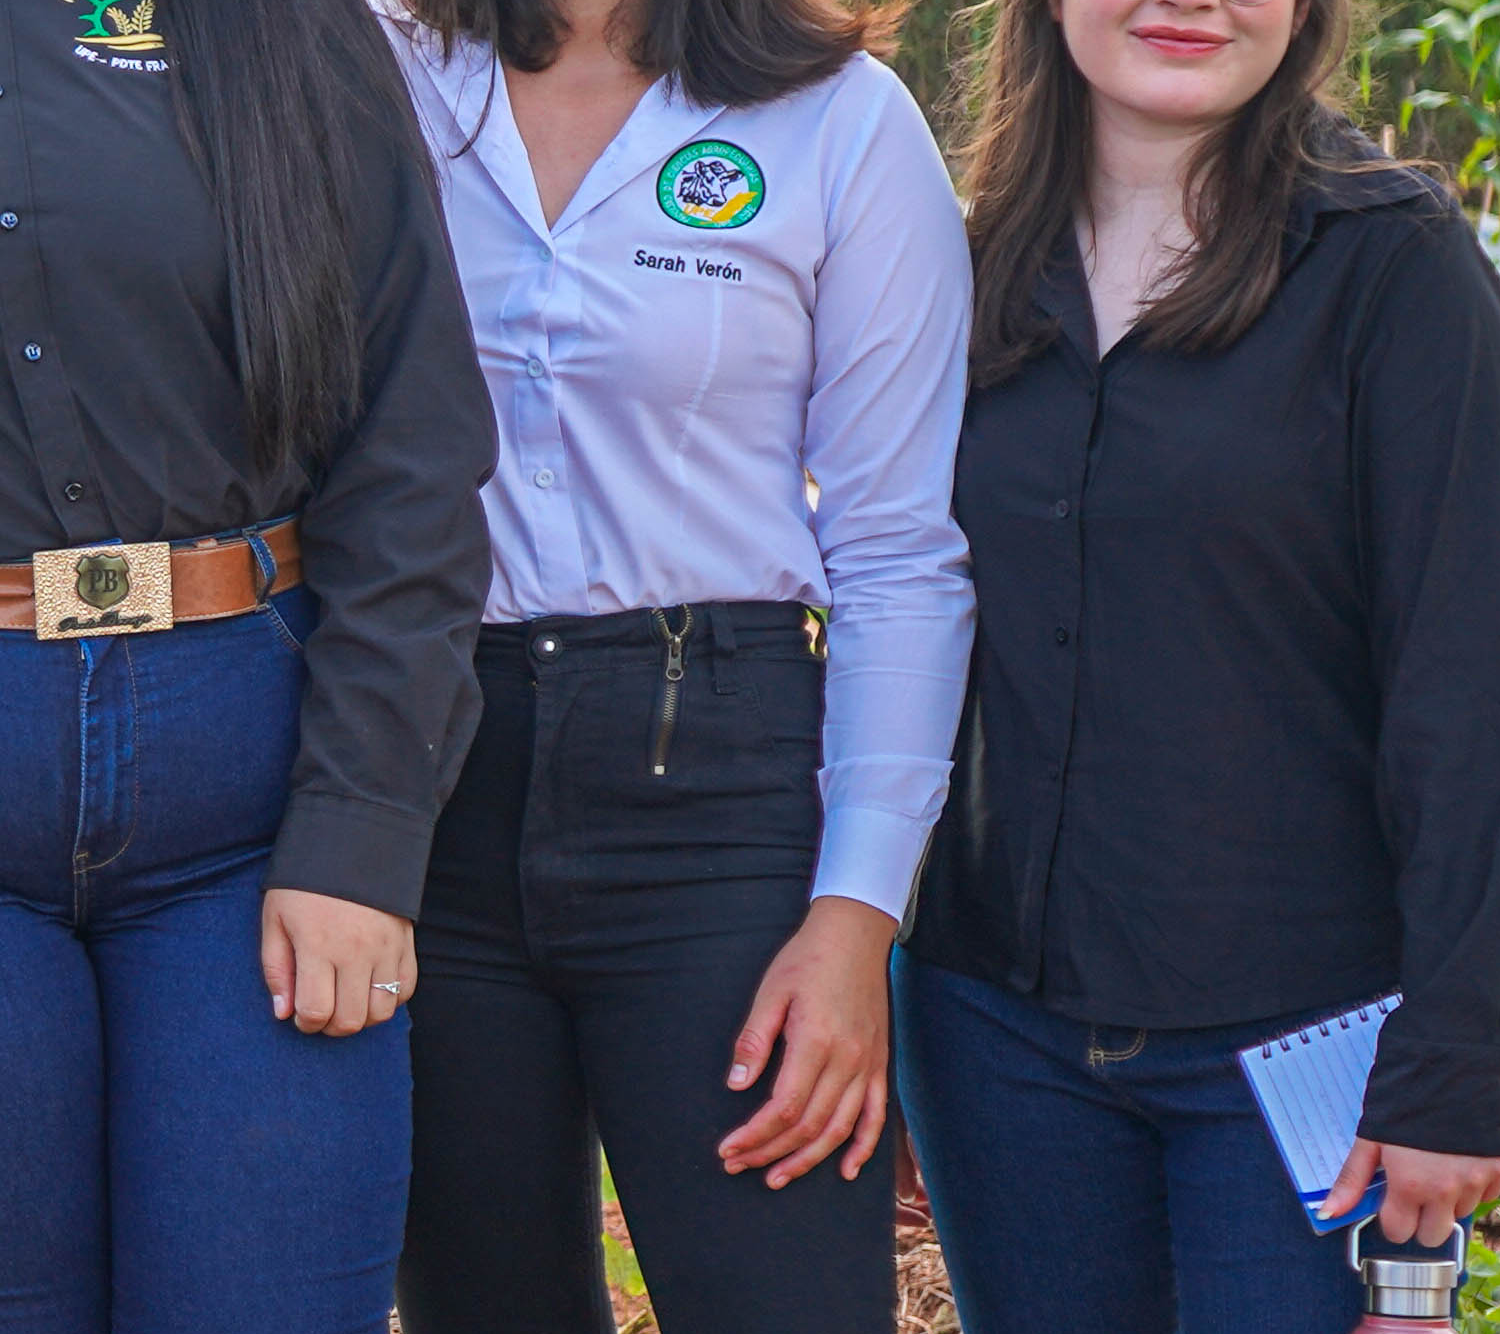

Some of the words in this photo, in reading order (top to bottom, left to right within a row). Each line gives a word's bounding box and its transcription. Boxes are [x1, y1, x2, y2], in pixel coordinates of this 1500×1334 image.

[111, 56, 144, 71] PDTE
[634, 249, 686, 273] Sarah
[696, 258, 742, 282] Verón
[88, 569, 119, 593] PB
